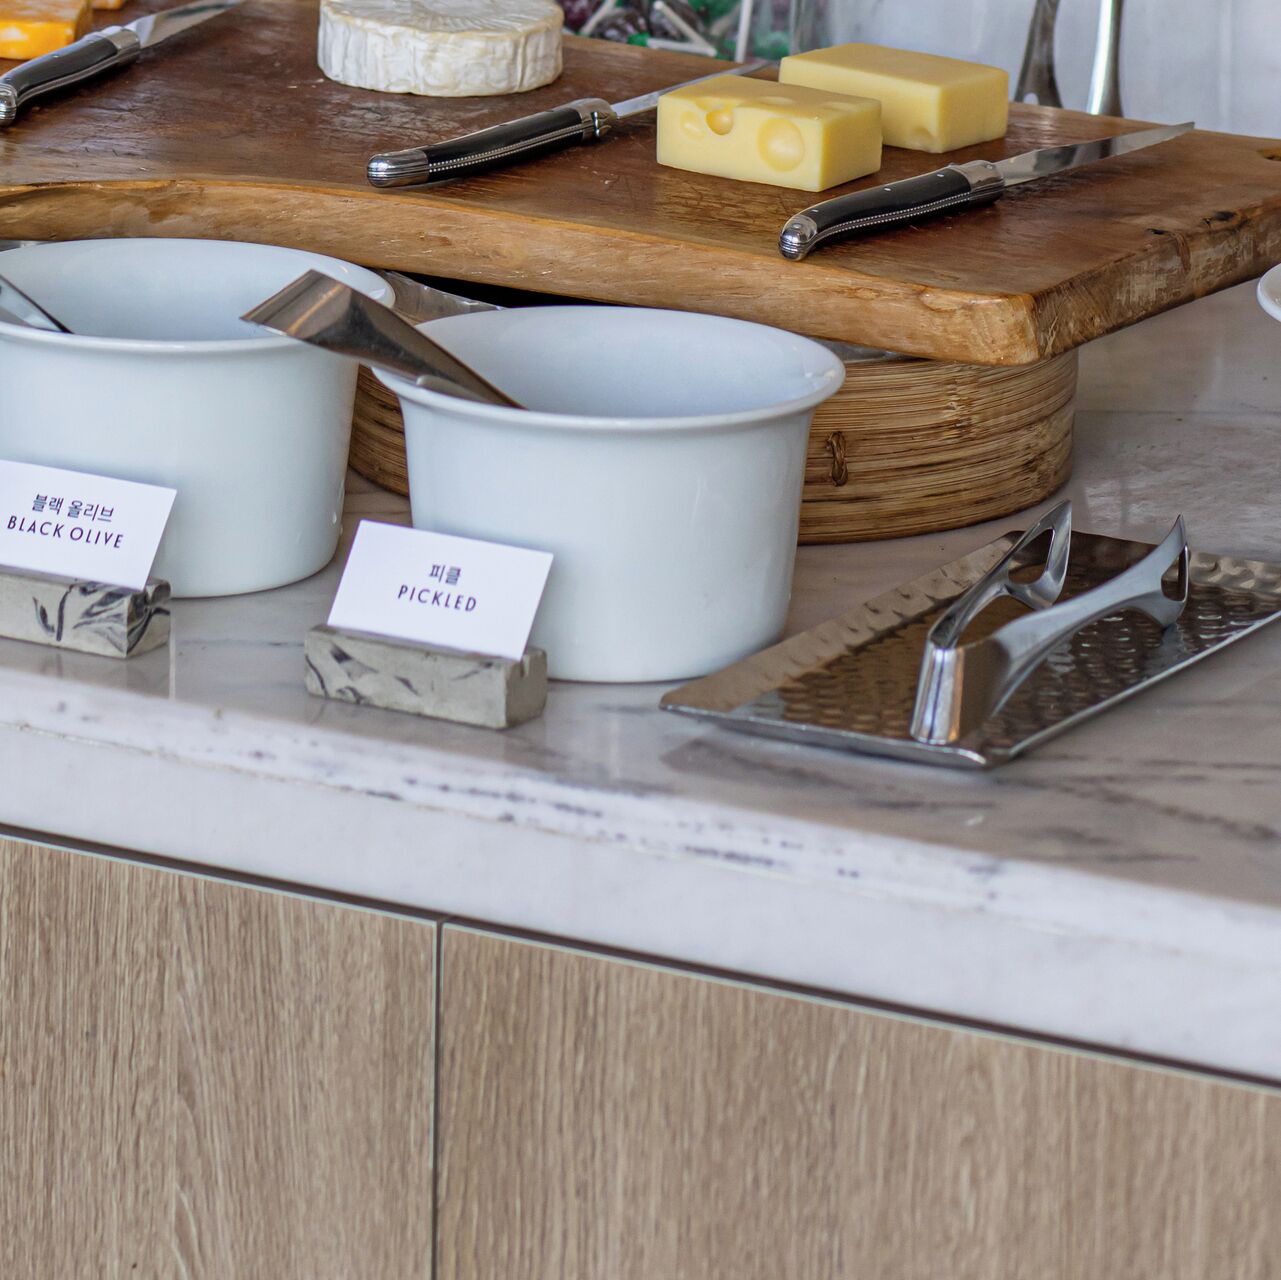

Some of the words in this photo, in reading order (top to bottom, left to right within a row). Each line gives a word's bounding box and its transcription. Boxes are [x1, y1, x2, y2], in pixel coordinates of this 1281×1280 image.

[31, 493, 65, 515] 블랙
[67, 500, 115, 523] 올리브
[6, 515, 65, 539] BLACK
[69, 526, 124, 549] OLIVE
[428, 564, 462, 586] 피클
[397, 584, 477, 612] PICKLED
